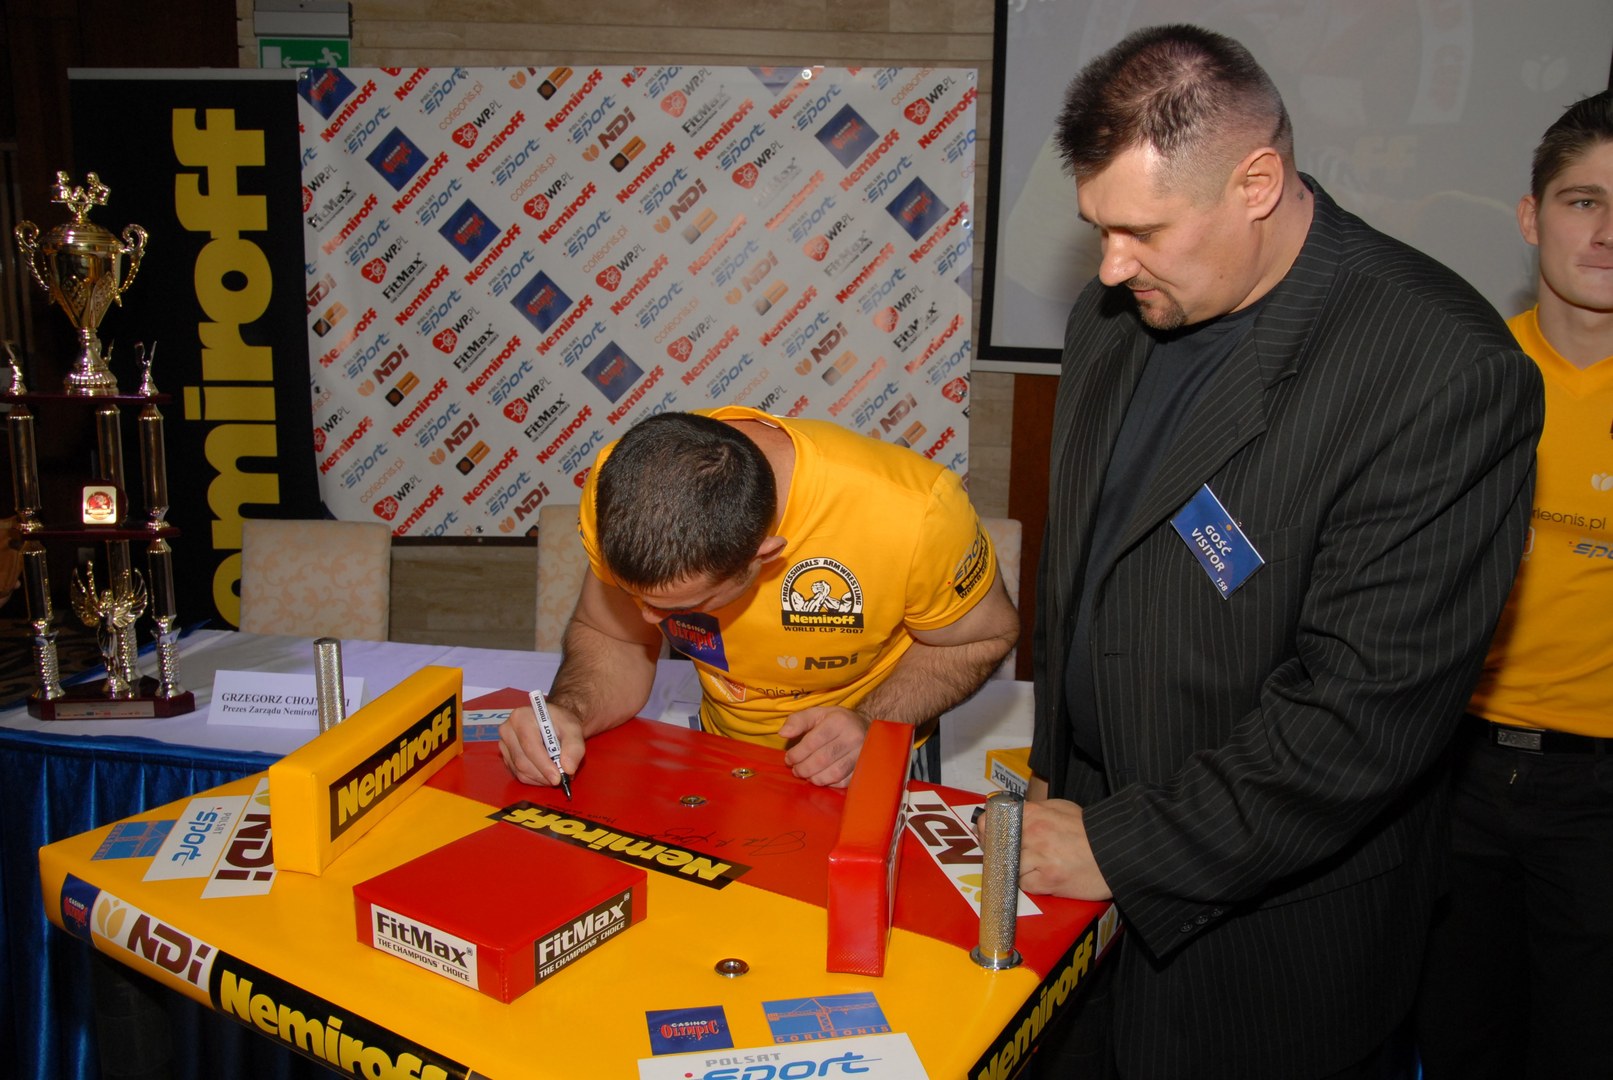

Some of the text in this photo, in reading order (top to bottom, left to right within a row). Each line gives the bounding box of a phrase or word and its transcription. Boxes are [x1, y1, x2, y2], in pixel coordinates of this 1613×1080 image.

[320, 80, 378, 143] Nemiroff
[544, 68, 604, 133] Nemiroff
[694, 98, 755, 160] Nemiroff
[917, 87, 979, 150] Nemiroff
[466, 110, 526, 173] Nemiroff
[839, 128, 900, 192] Nemiroff
[391, 151, 449, 214] Nemiroff
[615, 142, 676, 204] Nemiroff
[538, 181, 598, 245] Nemiroff
[909, 202, 969, 263] Nemiroff
[382, 256, 423, 300] FitMax
[464, 223, 522, 286] Nemiroff
[395, 264, 450, 326] Nemiroff
[609, 254, 670, 316] Nemiroff
[536, 294, 594, 356] Nemiroff
[759, 285, 817, 347] Nemiroff
[172, 108, 280, 629] miroff
[453, 326, 494, 370] FitMax
[465, 335, 522, 395] Nemiroff
[681, 325, 740, 386] Nemiroff
[392, 377, 448, 437] Nemiroff
[524, 396, 565, 440] FitMax
[607, 365, 665, 425] Nemiroff
[319, 416, 373, 475] Nemiroff
[536, 405, 593, 465] Nemiroff
[922, 426, 956, 460] iroff
[463, 446, 519, 505] Nemiroff
[1205, 524, 1232, 556] GOŚĆ
[1532, 507, 1606, 530] rleonis.pl
[1191, 528, 1225, 572] VISITOR
[1216, 578, 1228, 592] 158
[676, 620, 706, 634] CASINO
[790, 614, 855, 625] Nemiroff
[222, 692, 282, 704] GRZEGORZ
[222, 704, 247, 712] Prezes
[248, 706, 281, 716] Zarządu
[544, 725, 554, 745] PILOT
[338, 706, 452, 826] Nemiroff
[171, 810, 218, 862] sport
[212, 812, 232, 834] POLSAT
[502, 806, 732, 881] Nemiroff
[378, 938, 470, 982] THE CHAMPIONS' CHOICE
[539, 921, 624, 978] THE CHAMPIONS' CHOICE
[671, 1020, 708, 1028] CASINO
[776, 1025, 890, 1044] CORLEONIS
[978, 930, 1094, 1080] Nemiroff
[705, 1052, 782, 1068] POLSAT
